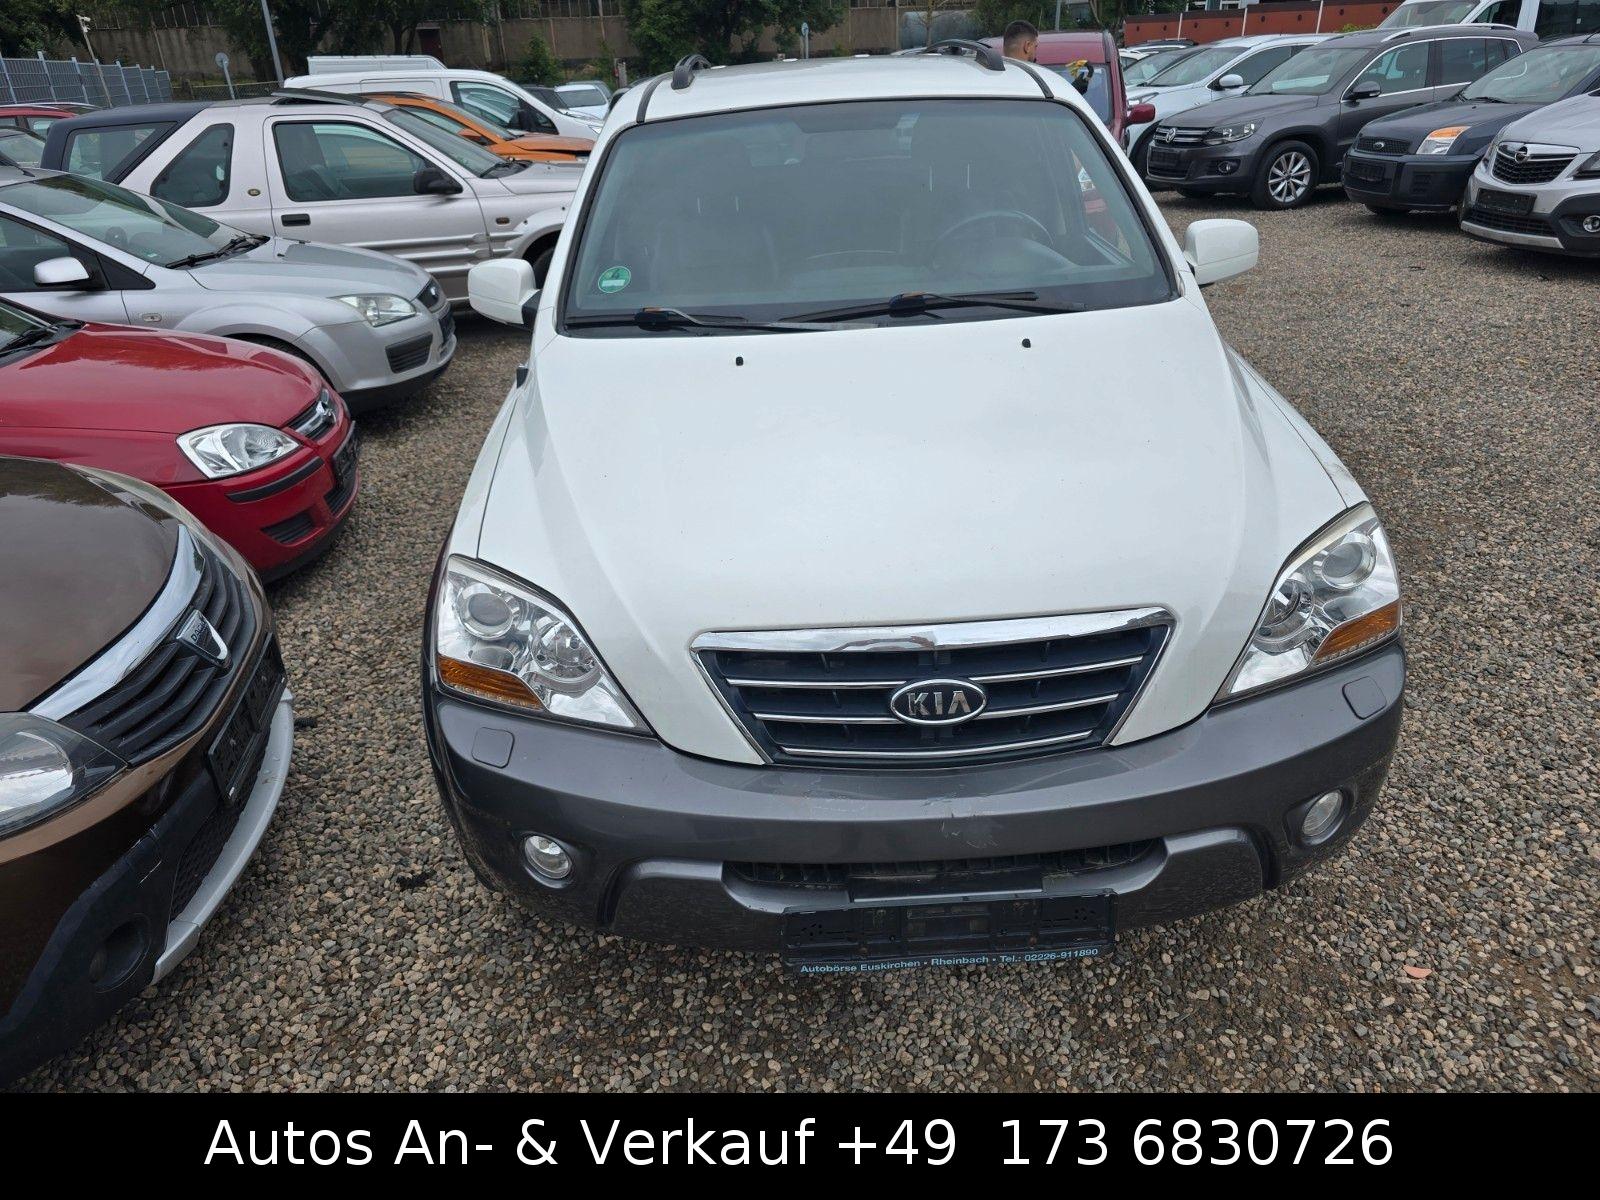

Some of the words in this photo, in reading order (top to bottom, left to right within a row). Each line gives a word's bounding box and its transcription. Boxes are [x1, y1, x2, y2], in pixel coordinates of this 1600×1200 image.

[906, 690, 972, 716] KIA
[800, 963, 857, 973] Autobörse
[860, 960, 921, 971] Euskirchen
[931, 955, 989, 966] Rheinbach
[1000, 954, 1021, 963] Tel.:
[1024, 948, 1099, 962] 02226-911890
